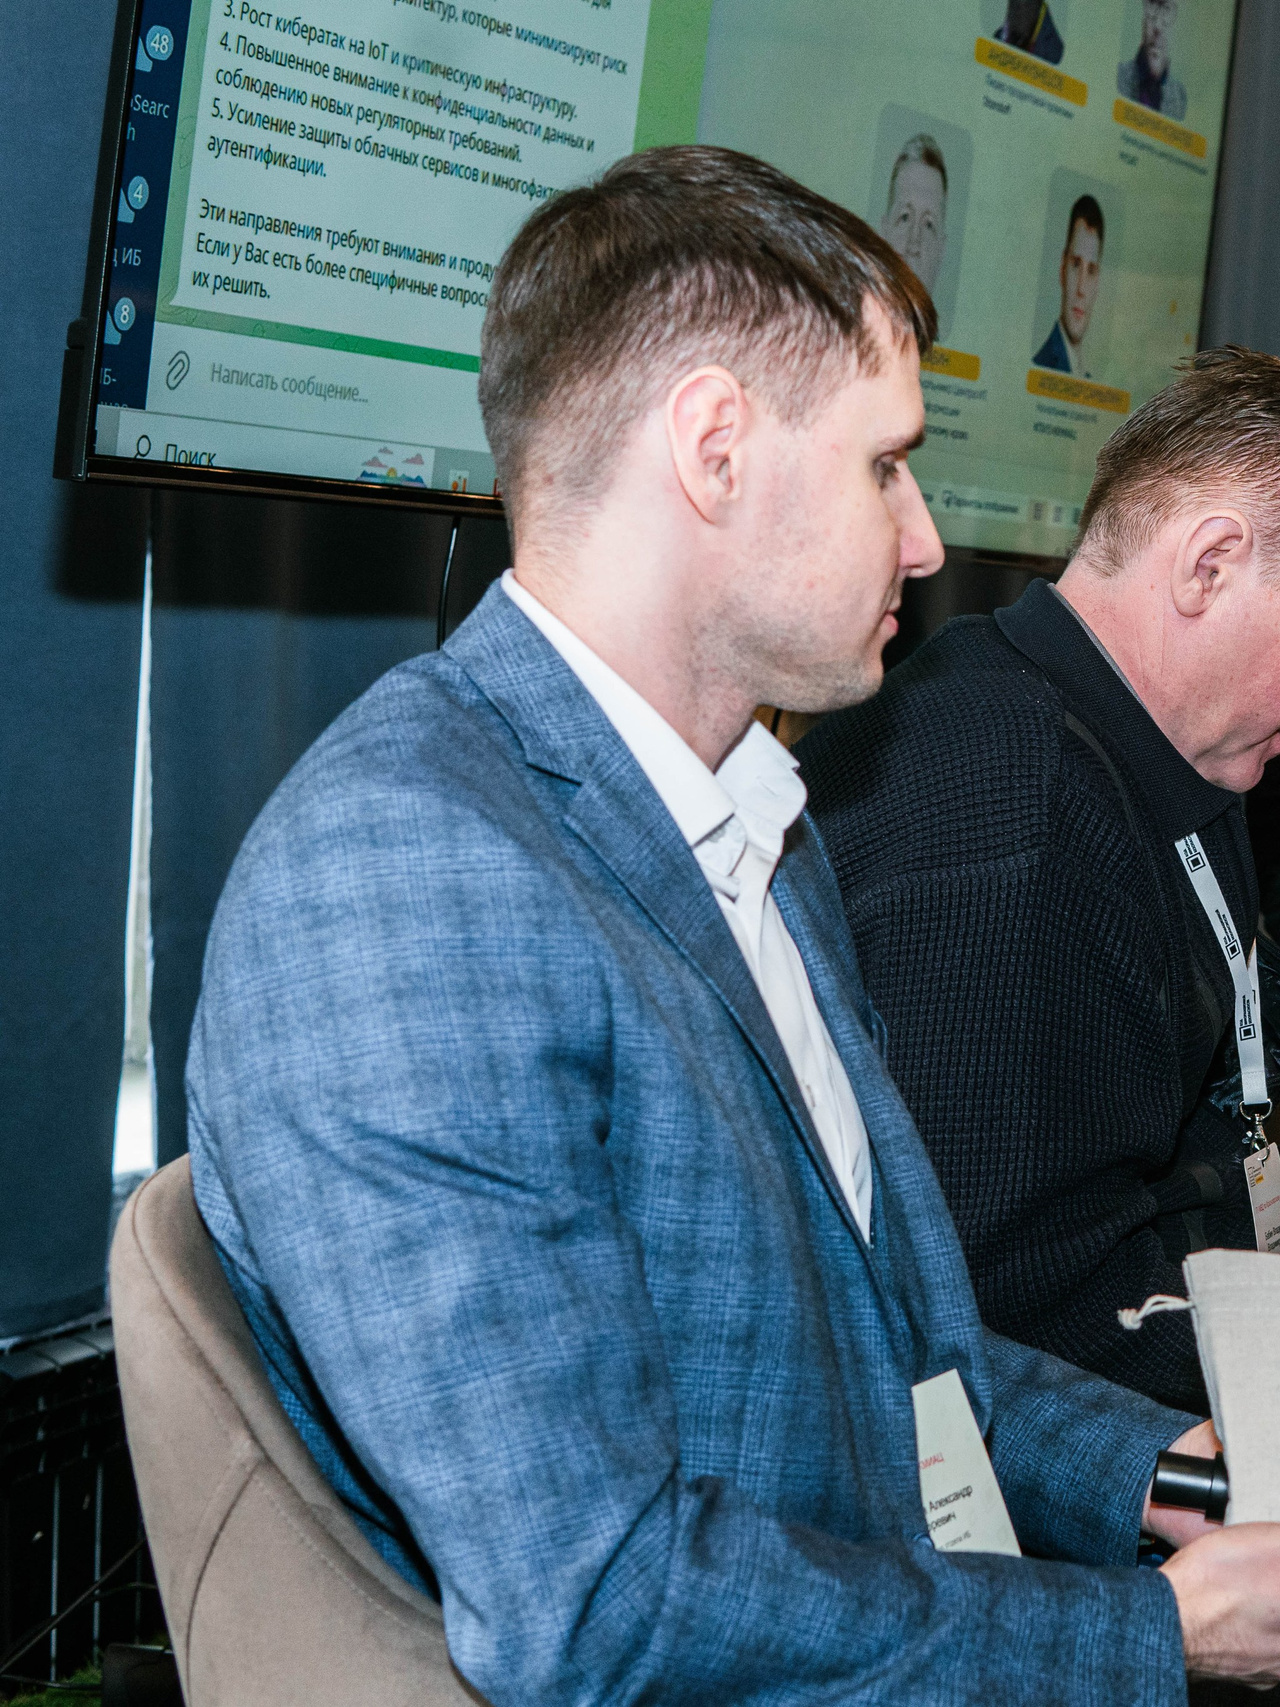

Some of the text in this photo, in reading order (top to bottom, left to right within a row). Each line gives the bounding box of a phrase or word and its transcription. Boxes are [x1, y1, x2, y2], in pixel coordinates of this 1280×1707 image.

[150, 33, 170, 54] 48
[461, 8, 513, 38] которые
[515, 26, 601, 66] минимизируют
[602, 54, 628, 75] риск
[223, 0, 578, 122] 3. Рост кибератак на IoT и критическую инфраструктуру.
[131, 93, 171, 119] Searc
[219, 31, 596, 153] 4. Повышенное внимание к конфиденциальности данных и
[215, 67, 522, 163] соблюдению новых регуляторных требований.
[126, 121, 136, 141] h
[210, 97, 223, 119] 5.
[227, 100, 296, 137] Усиление
[298, 122, 352, 151] защиты
[354, 135, 420, 168] облачных
[421, 153, 479, 183] сервисов
[480, 170, 490, 185] и
[207, 134, 327, 178] аутентификации.
[132, 183, 144, 202] 4
[198, 197, 226, 222] Эти
[228, 207, 323, 243] направления
[325, 226, 380, 257] требуют
[382, 240, 446, 268] внимания
[448, 255, 458, 270] и
[121, 247, 142, 267] ИБ
[196, 231, 231, 258] Если
[232, 243, 242, 265] у
[244, 241, 270, 266] Вас
[272, 251, 303, 272] есть
[305, 253, 347, 280] более
[349, 265, 439, 298] специфичные
[191, 269, 271, 300] их решить.
[119, 304, 131, 325] 8
[100, 367, 118, 386] Б-
[210, 362, 369, 404] Написать сообщение...
[165, 443, 217, 467] Поиск
[929, 1484, 974, 1512] Александр
